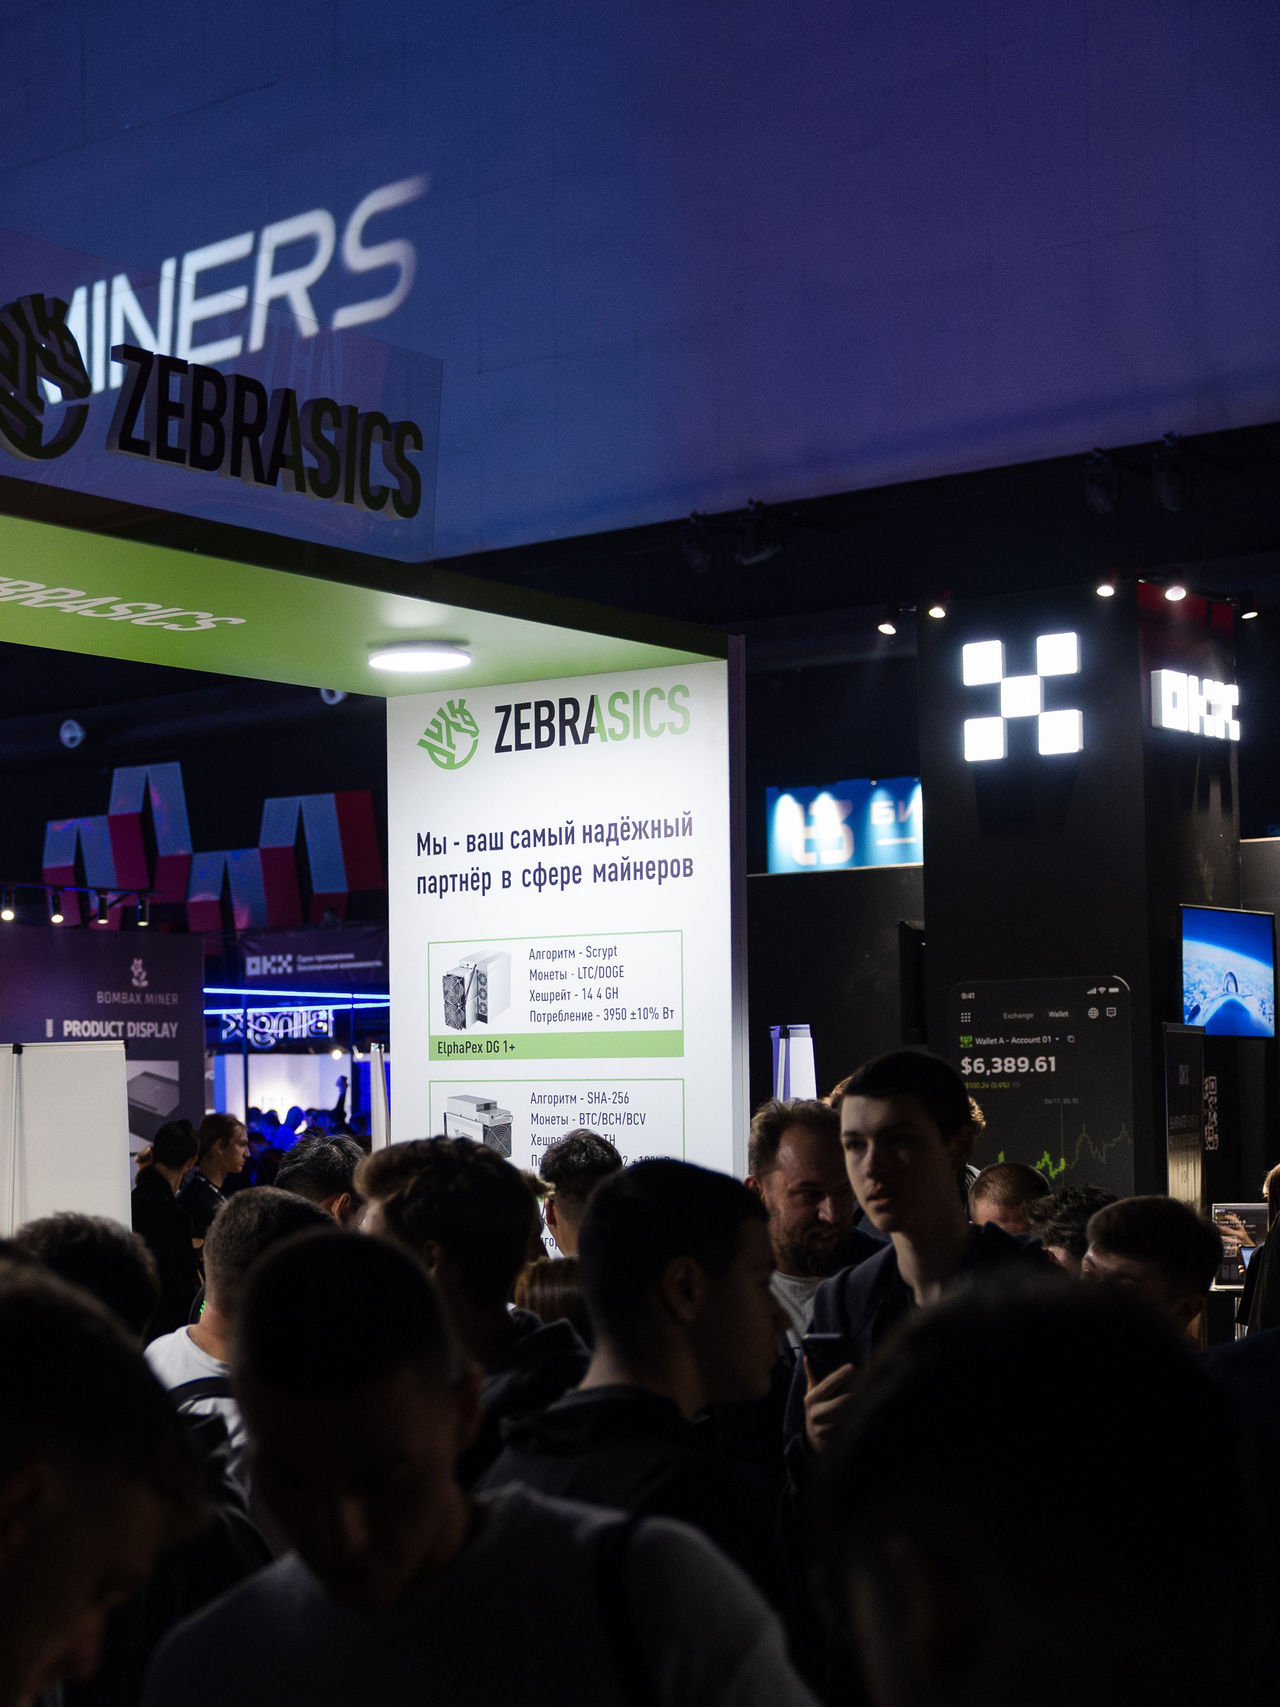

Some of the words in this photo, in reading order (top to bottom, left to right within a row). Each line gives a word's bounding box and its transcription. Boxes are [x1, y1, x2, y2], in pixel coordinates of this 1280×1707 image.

[105, 343, 424, 520] ZEBRASICS
[494, 684, 690, 754] ZEBRASICS
[416, 831, 447, 856] Мы
[466, 831, 504, 853] ваш
[510, 819, 576, 848] самый
[581, 810, 694, 846] надёжный
[416, 866, 492, 899] партнёр
[501, 869, 512, 889] в
[521, 861, 583, 893] сфере
[592, 855, 695, 886] майнеров
[529, 948, 576, 962] Алгоритм
[586, 944, 618, 961] Scrypt
[245, 953, 294, 977] OKX
[529, 967, 567, 981] Монеты
[578, 965, 625, 980] LTC/DOGE
[96, 990, 142, 1005] BOMBAX
[144, 993, 179, 1006] MINER
[529, 988, 571, 1004] Хешрейт
[582, 987, 594, 1001] 14
[605, 985, 619, 1000] GH
[960, 992, 975, 1000] 9:41
[529, 1009, 593, 1024] Потребление
[603, 1007, 627, 1022] 3950
[630, 1006, 660, 1020] ±10%
[663, 1005, 674, 1020] Вт
[1003, 1011, 1035, 1020] Exchange
[1048, 1009, 1070, 1018] Wallet
[62, 1019, 125, 1038] PRODUCT
[126, 1021, 179, 1039] DISPLAY
[437, 1041, 483, 1057] ElphaPex
[486, 1040, 500, 1053] DG
[504, 1040, 516, 1053] 1+
[975, 1036, 998, 1046] Wallet
[998, 1036, 1005, 1045] A
[1010, 1035, 1041, 1045] Account
[1042, 1034, 1052, 1044] 01
[960, 1055, 1057, 1076] $6,389.61
[530, 1092, 577, 1107] Алгоритм
[587, 1091, 630, 1105] SHA-256
[531, 1113, 569, 1126] Монеты
[579, 1112, 647, 1127] BTC/BCH/BCV
